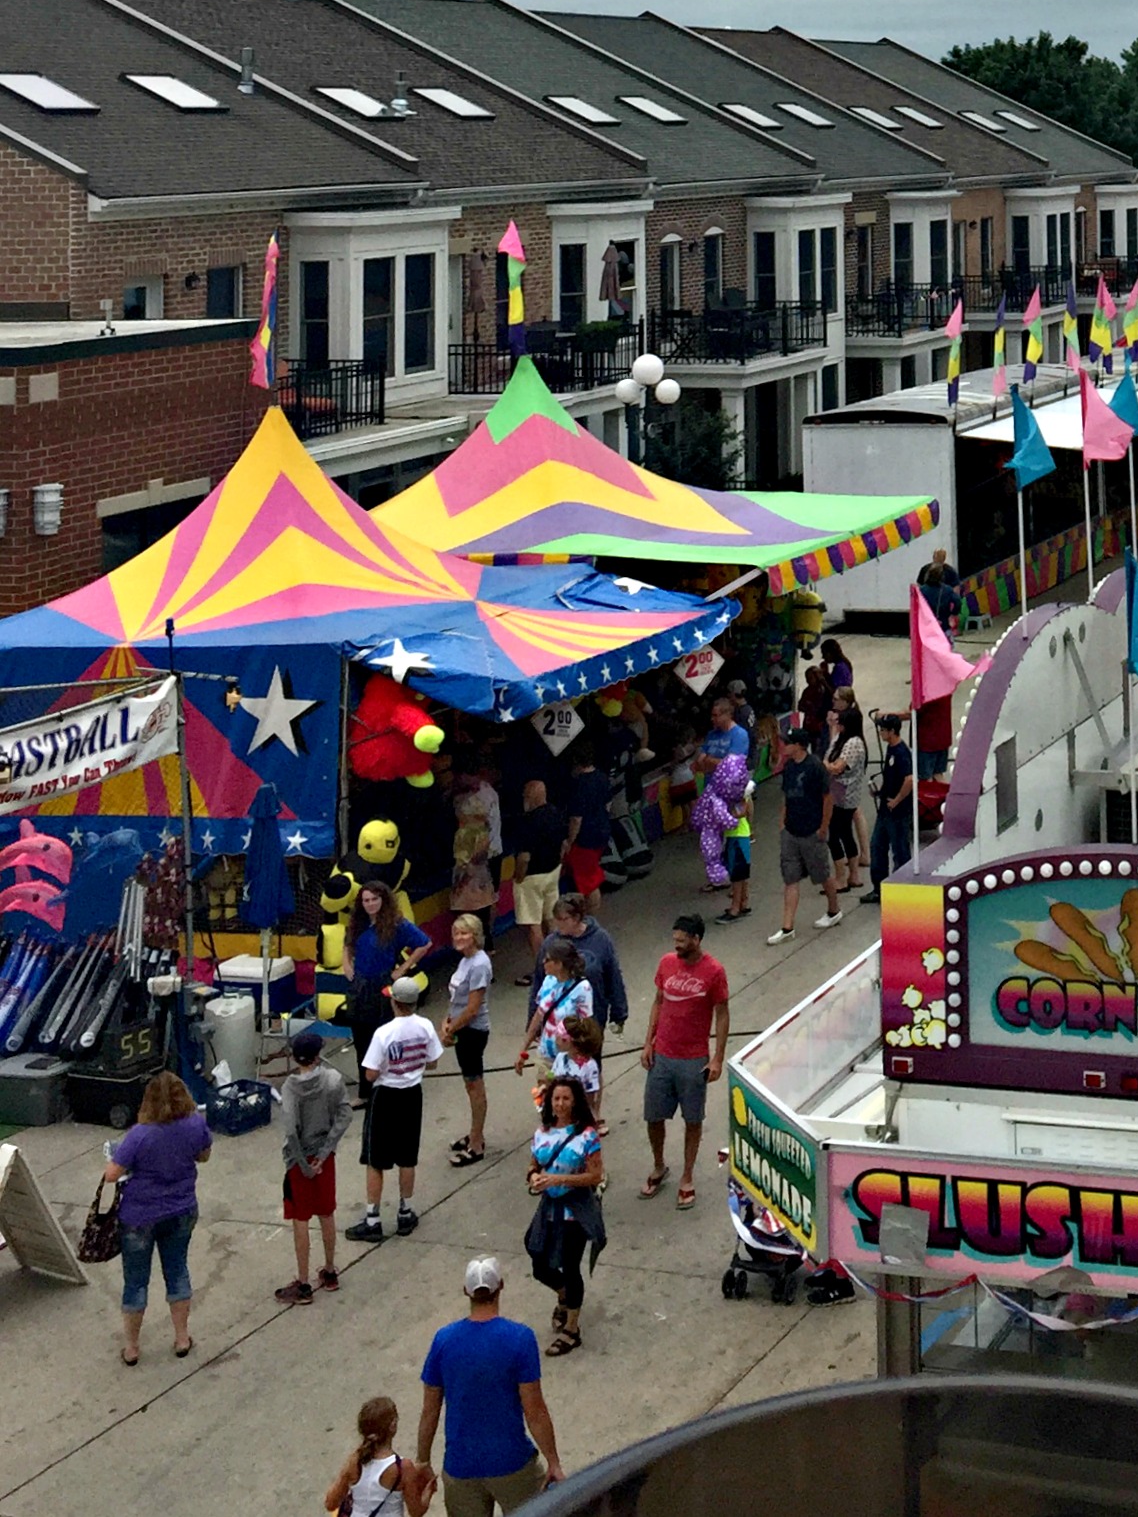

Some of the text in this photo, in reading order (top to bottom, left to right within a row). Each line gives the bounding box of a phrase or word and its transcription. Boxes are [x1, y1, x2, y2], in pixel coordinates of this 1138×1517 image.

[0, 706, 140, 780] ASTBALL
[28, 779, 59, 799] FAST
[61, 774, 81, 790] You
[83, 767, 102, 782] Can
[996, 976, 1138, 1037] CORN
[121, 1028, 151, 1060] 55
[748, 1106, 812, 1181] FRESH SQUEEZED
[734, 1132, 812, 1234] LEMONADE
